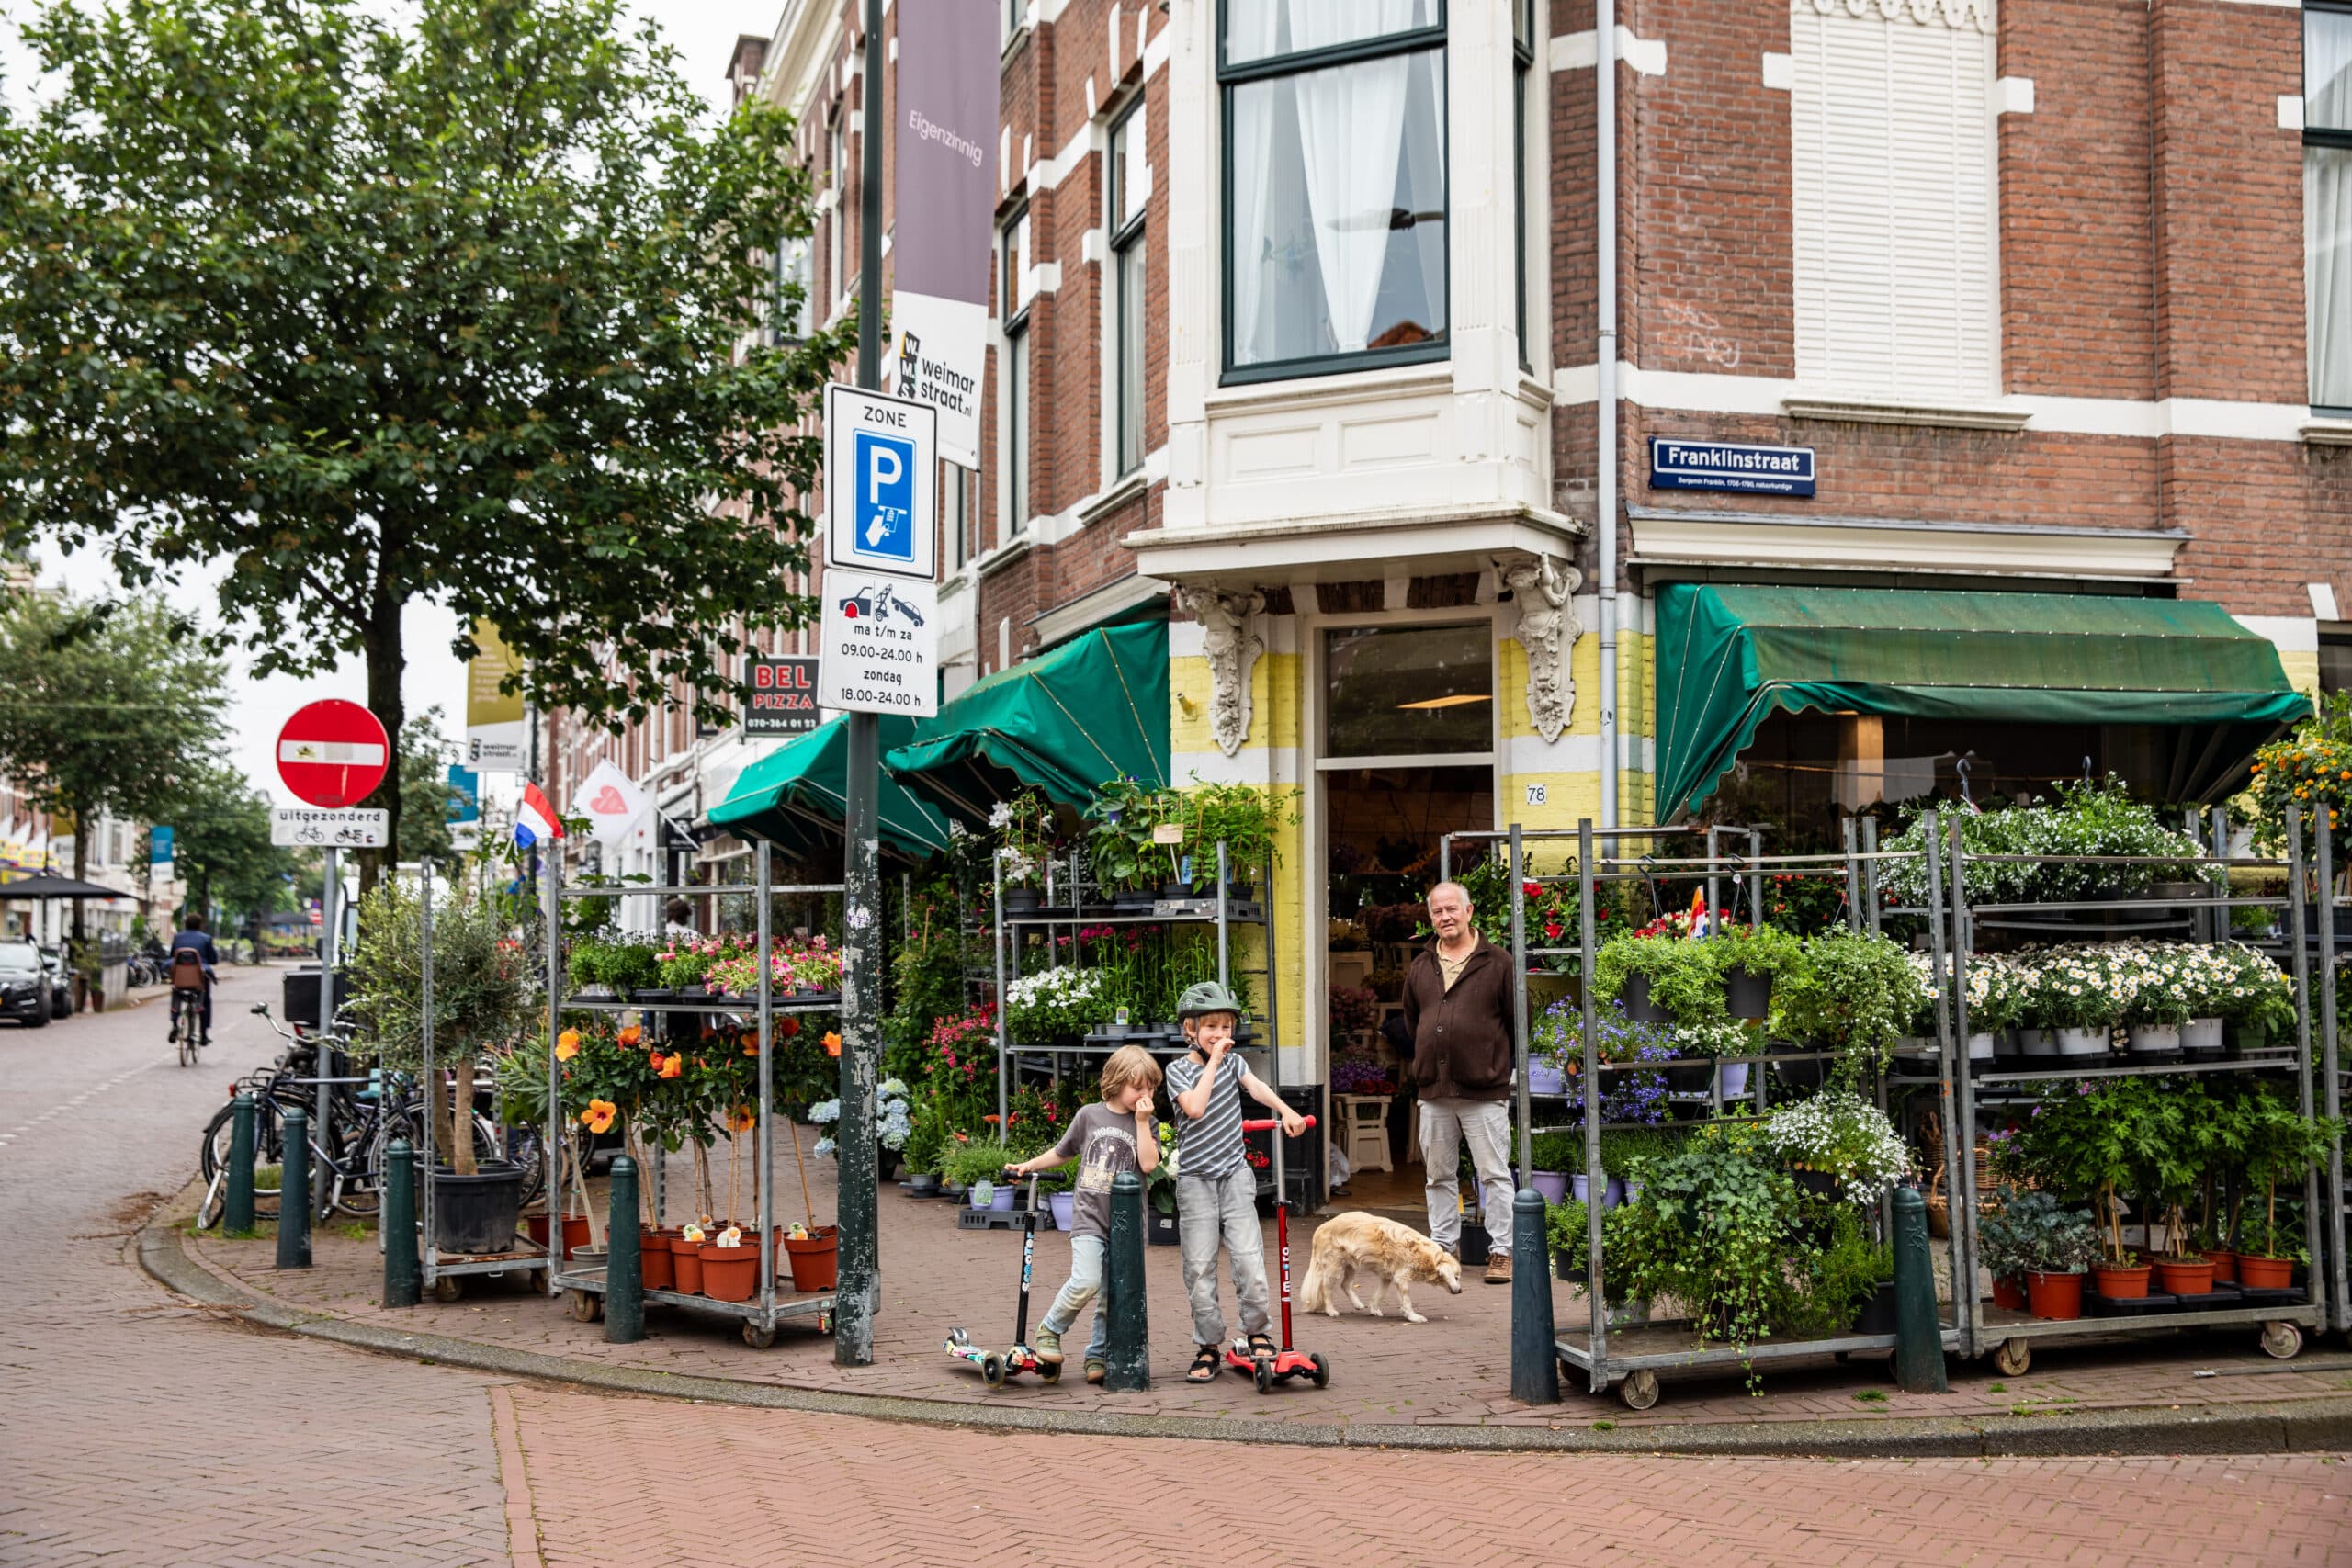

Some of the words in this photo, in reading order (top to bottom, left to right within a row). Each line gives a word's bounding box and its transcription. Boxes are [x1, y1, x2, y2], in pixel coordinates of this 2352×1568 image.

[909, 109, 983, 167] Eigenzinnig
[922, 358, 975, 395] weimar
[921, 381, 972, 417] straat.nl
[864, 406, 907, 428] ZONE
[1668, 446, 1800, 471] Franklinstraat
[870, 445, 903, 505] P
[854, 626, 871, 635] ma
[876, 625, 896, 638] t/m
[900, 631, 912, 640] za
[842, 643, 912, 662] 09.00-24.00
[916, 652, 922, 663] h
[755, 664, 812, 689] BEL
[864, 670, 902, 686] zondag
[753, 694, 814, 709] PIZZA
[842, 687, 910, 705] 18.00-24.00
[914, 694, 921, 706] h
[1528, 787, 1544, 801] 78
[279, 810, 381, 823] uitgezonderd
